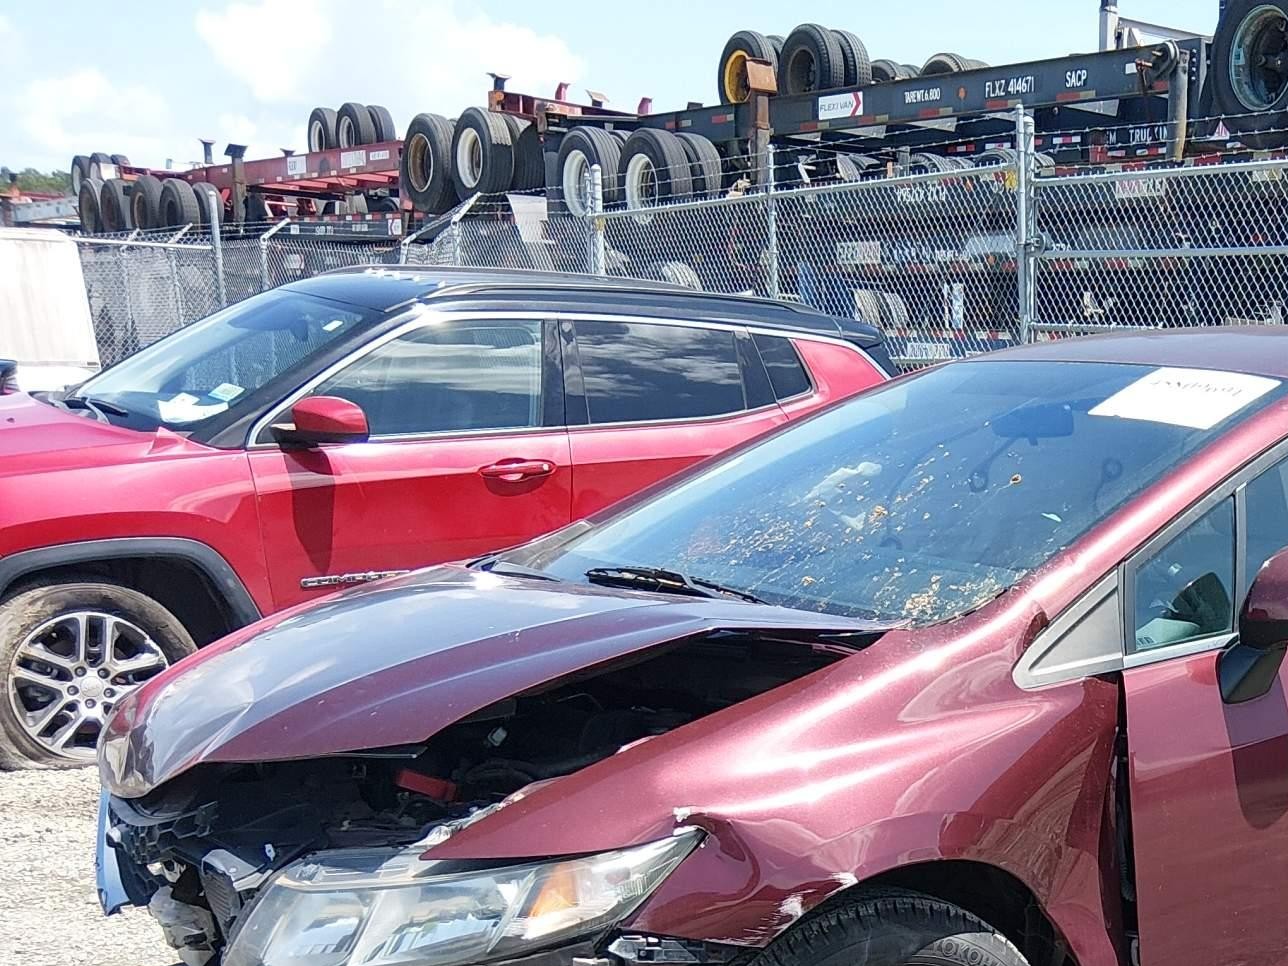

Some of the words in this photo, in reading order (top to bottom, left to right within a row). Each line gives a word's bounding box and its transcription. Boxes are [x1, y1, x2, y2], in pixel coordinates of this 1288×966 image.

[985, 80, 1006, 98] FLXZ
[1007, 75, 1035, 95] 414671
[1065, 69, 1087, 88] SACP
[301, 570, 409, 588] COMPAS
